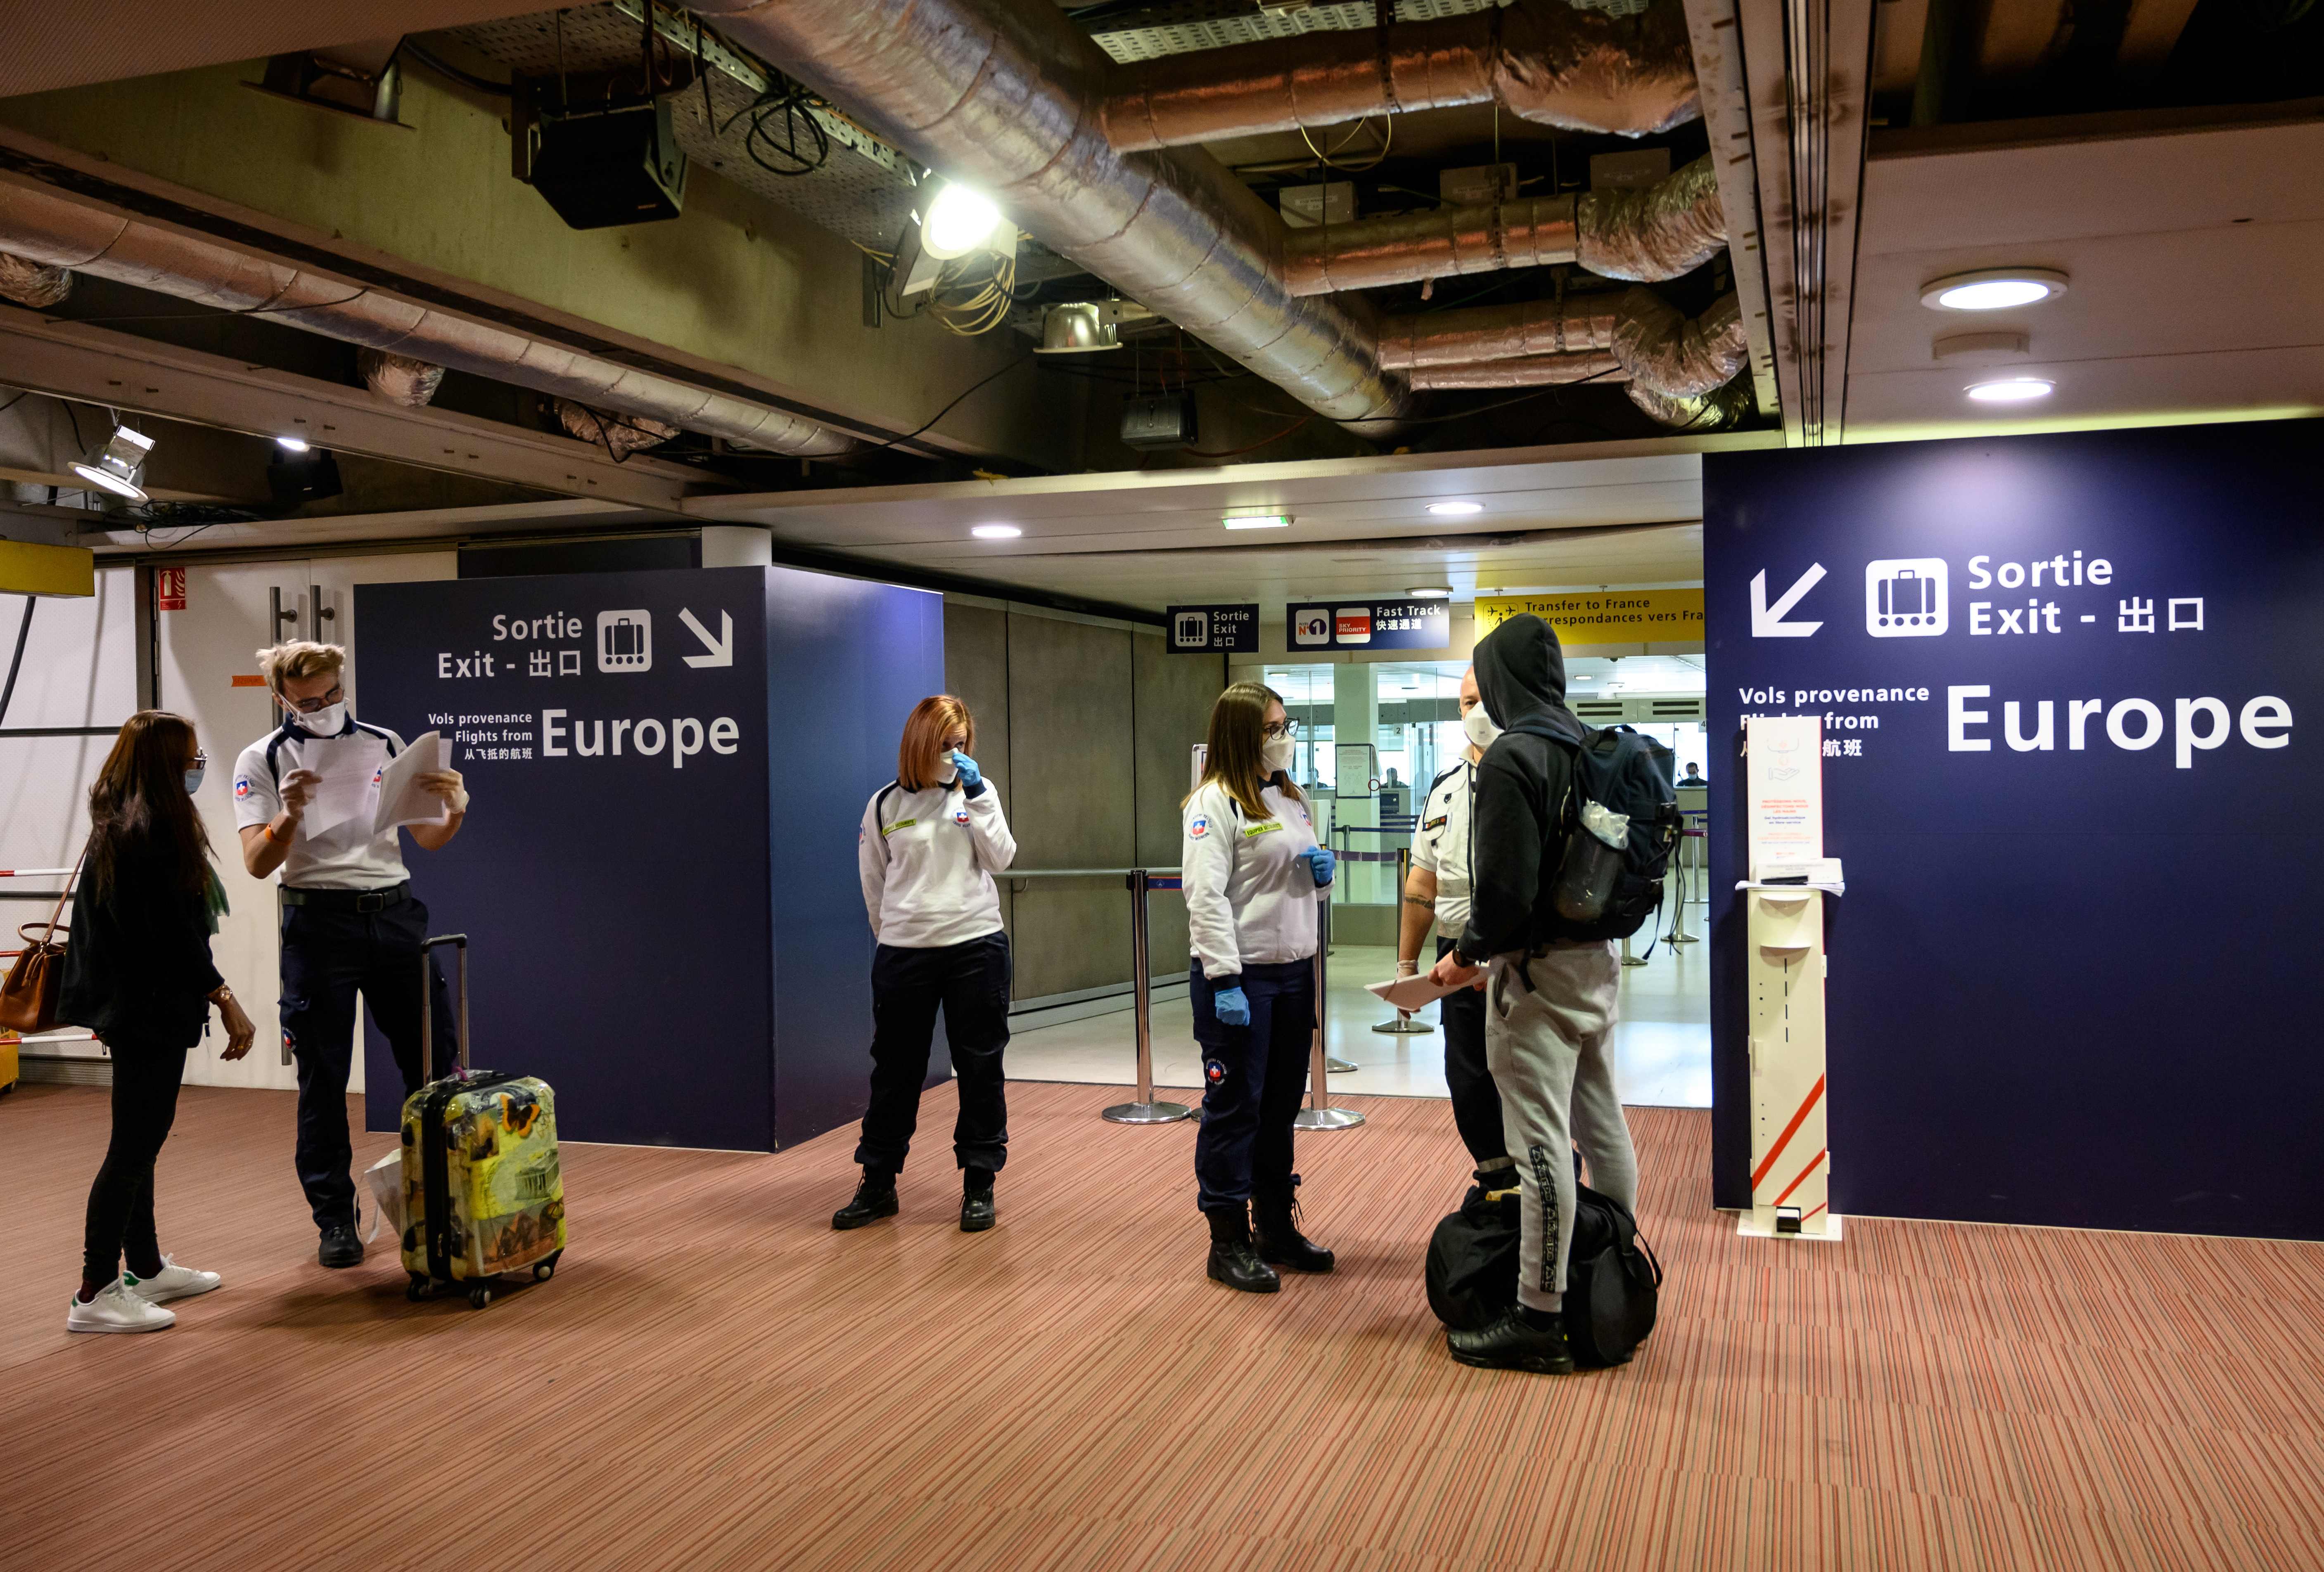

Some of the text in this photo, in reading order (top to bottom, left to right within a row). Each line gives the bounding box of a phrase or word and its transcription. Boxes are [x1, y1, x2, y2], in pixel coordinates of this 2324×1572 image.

[1968, 550, 2113, 590] Sortie
[1377, 604, 1441, 617] Fast Track
[1525, 599, 1650, 611] Transfer to France
[1214, 611, 1249, 621] Sortie
[1648, 613, 1677, 621] vers
[1969, 598, 2061, 635] Exit
[2118, 597, 2203, 633] 出口
[493, 611, 582, 641] Sortie
[1214, 623, 1236, 634] Exit
[1376, 618, 1422, 631] 快速通道
[1214, 637, 1234, 646] 出口
[439, 651, 494, 678] Exit
[529, 649, 581, 677] 出口
[1739, 686, 1929, 708] Vols provenance
[428, 713, 532, 727] Vols provenance
[1824, 711, 1878, 729] from
[1947, 685, 2293, 769] Europe
[456, 729, 532, 745] Flights from
[543, 709, 739, 769] Europe
